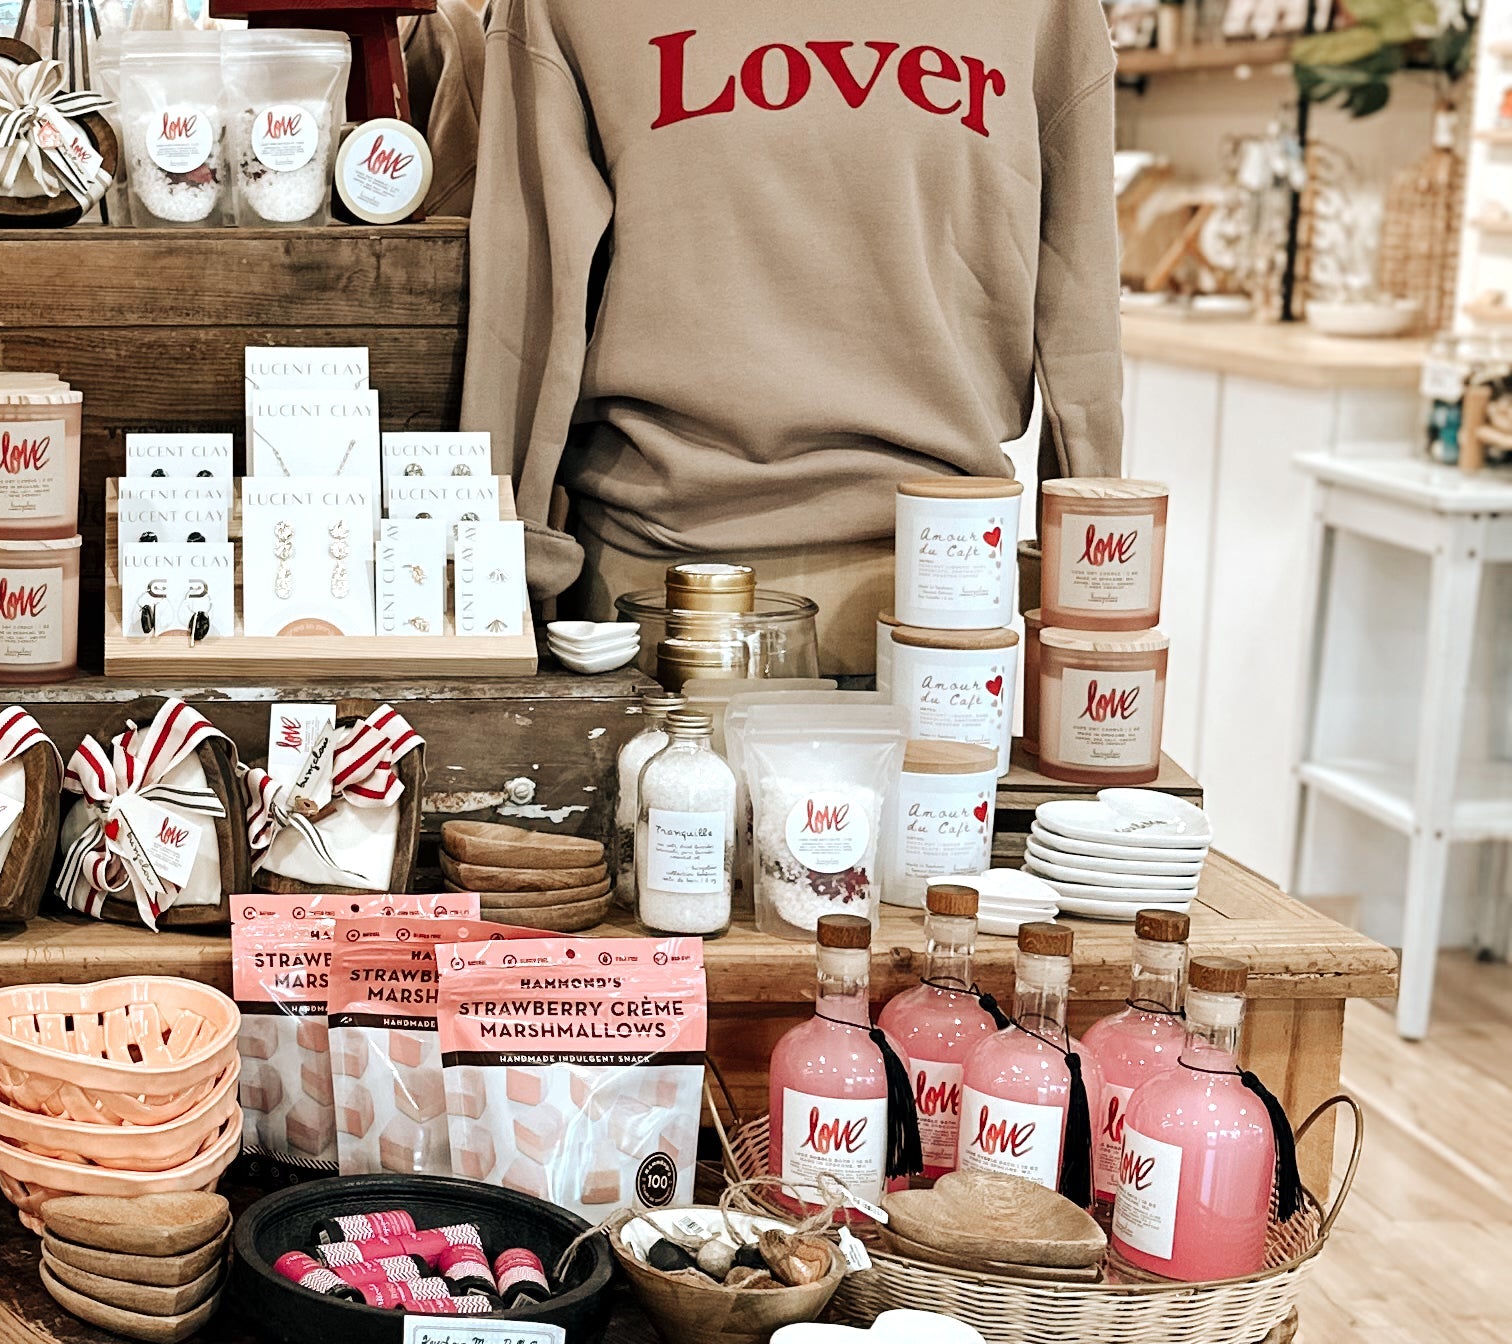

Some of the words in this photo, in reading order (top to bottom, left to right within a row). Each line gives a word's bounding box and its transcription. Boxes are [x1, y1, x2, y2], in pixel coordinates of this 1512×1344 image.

[648, 29, 1006, 137] Lover
[157, 112, 197, 140] love
[263, 111, 302, 139] love
[357, 134, 414, 180] love
[251, 363, 311, 375] LUCENT
[321, 363, 363, 375] CLAY
[258, 404, 321, 417] LUCENT
[330, 404, 373, 417] CLAY
[129, 446, 183, 457] LUCENT
[191, 446, 229, 457] CLAY
[384, 444, 439, 456] LUCENT
[448, 444, 486, 456] CLAY
[248, 493, 313, 506] LUCENT
[322, 493, 368, 506] CLAY
[390, 488, 448, 500] LUCENT
[455, 488, 494, 500] CLAY
[120, 510, 177, 523] LUCENT
[185, 510, 224, 523] CLAY
[920, 527, 979, 541] Amour
[920, 543, 937, 555] du
[1076, 523, 1138, 566] love
[124, 556, 183, 568] LUCENT
[190, 556, 230, 568] CLAY
[383, 546, 395, 584] CLAY
[462, 546, 474, 584] CLAY
[383, 592, 395, 632] CENT
[462, 592, 474, 632] CENT
[922, 675, 982, 690] Amour
[920, 691, 940, 704] du
[1077, 679, 1140, 723] love
[276, 716, 303, 754] love
[800, 799, 850, 834] love
[908, 803, 970, 818] Amour
[155, 816, 189, 848] love
[655, 824, 713, 841] Tranquille
[907, 820, 928, 833] du
[520, 977, 622, 989] HAMMOND'S
[458, 1000, 603, 1017] STRAWBERRY
[611, 996, 685, 1017] CRÈME
[383, 1018, 436, 1028] HANDMADE
[480, 1022, 667, 1038] MARSHMALLOWS
[499, 1055, 555, 1064] HANDMADE
[558, 1055, 615, 1064] INDULGENT
[618, 1055, 650, 1064] SNACK
[800, 1106, 868, 1154] love
[970, 1105, 1036, 1157] love
[648, 1174, 668, 1189] 100
